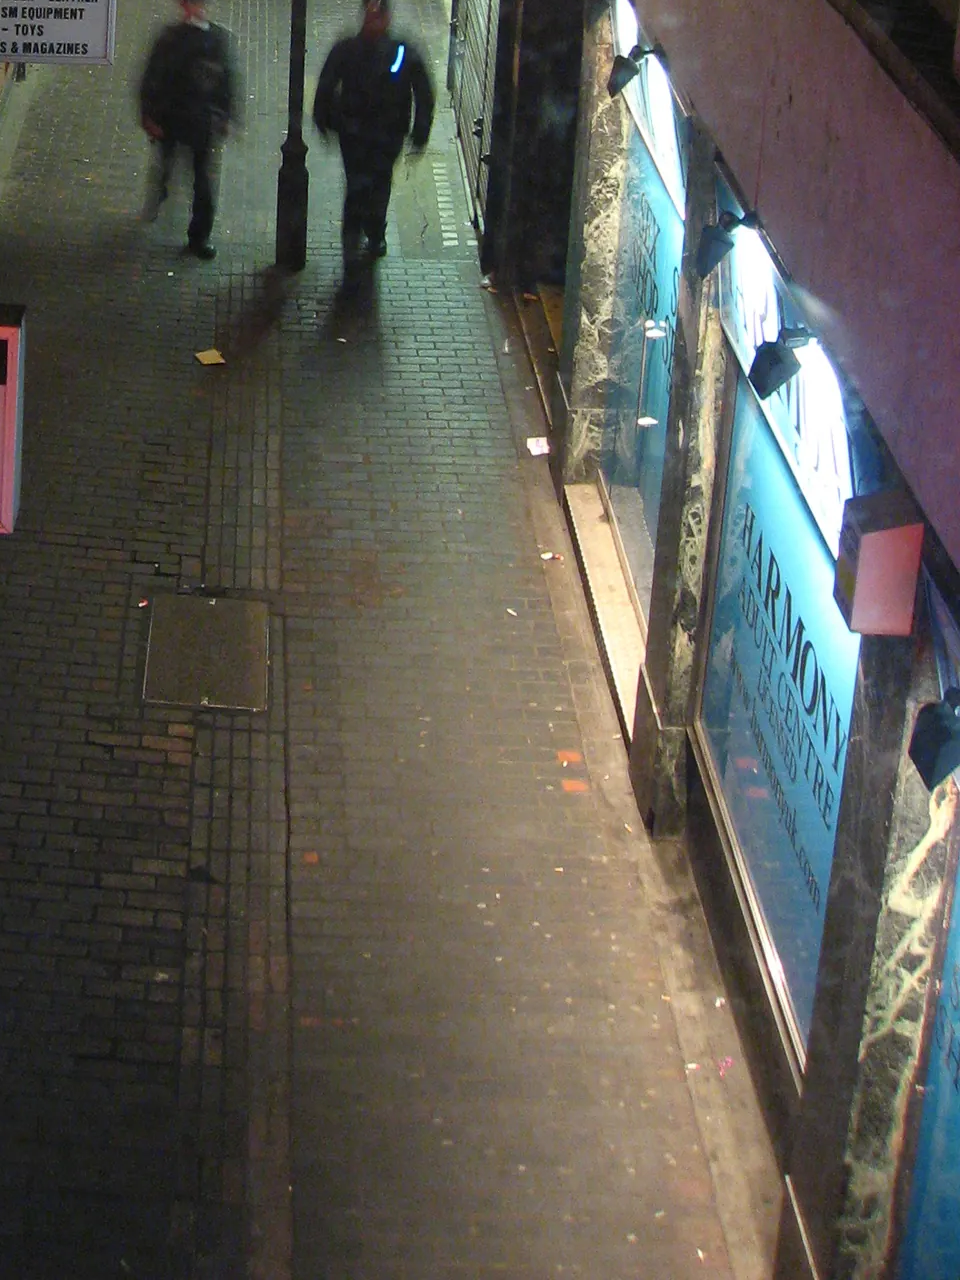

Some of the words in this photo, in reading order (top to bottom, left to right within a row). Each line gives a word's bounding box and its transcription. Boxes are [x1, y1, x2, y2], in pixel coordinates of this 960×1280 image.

[1, 6, 18, 19] SM
[21, 7, 86, 20] EQUIPMENT
[14, 24, 44, 37] TOYS
[22, 42, 89, 55] MAGAZINES
[742, 502, 847, 776] HARMONY
[737, 576, 777, 683] ADULT
[778, 671, 834, 832] CENTRE
